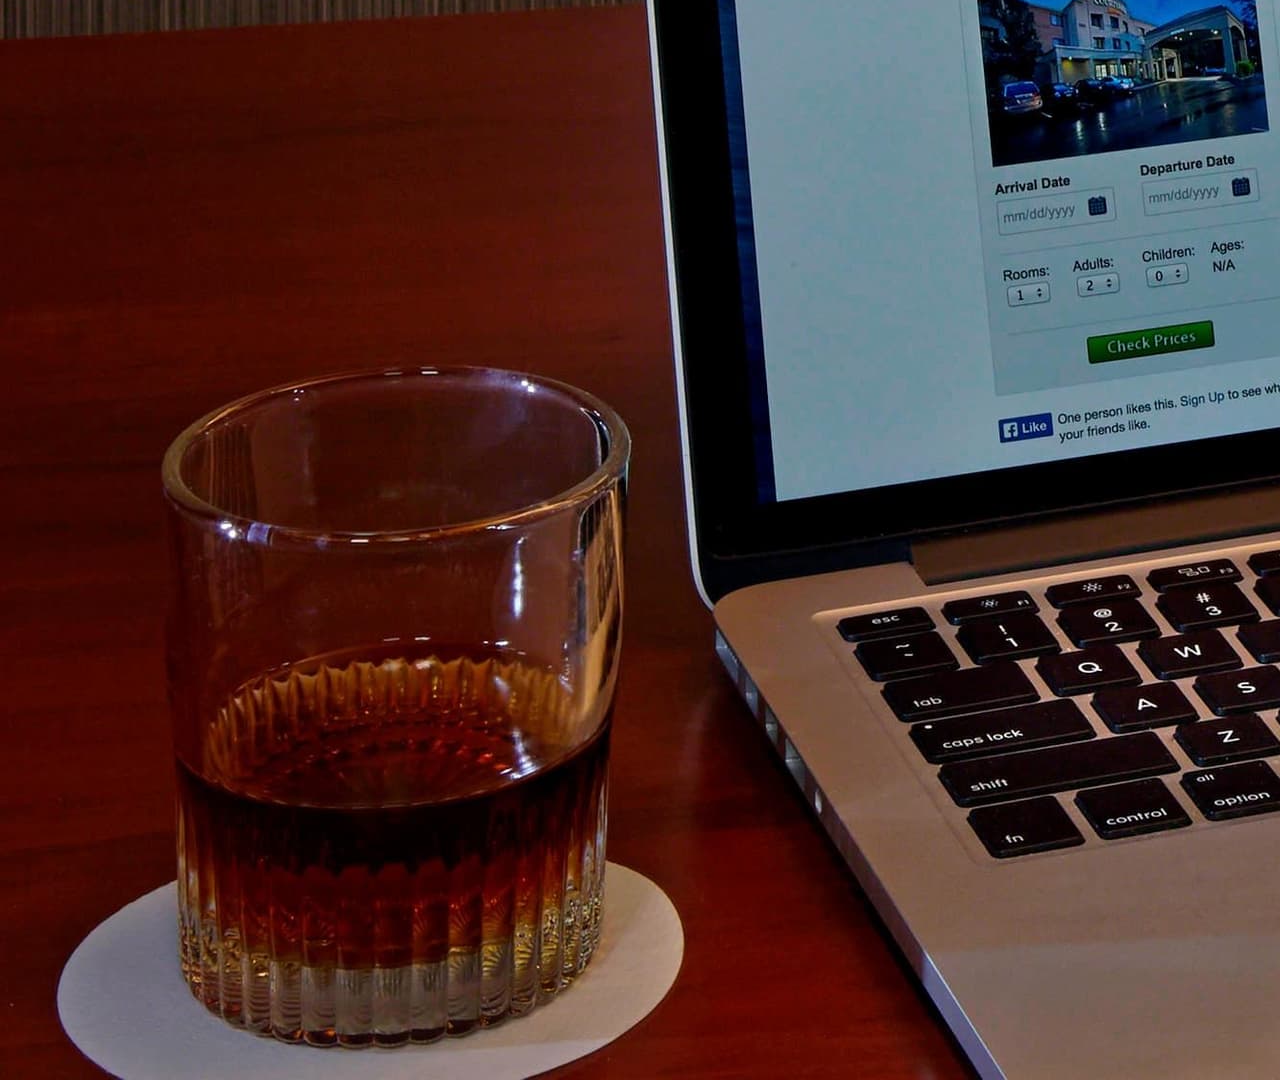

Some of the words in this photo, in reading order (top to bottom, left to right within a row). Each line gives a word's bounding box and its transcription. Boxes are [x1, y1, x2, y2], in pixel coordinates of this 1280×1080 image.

[1139, 159, 1203, 177] Departure
[1205, 154, 1235, 168] Date
[994, 178, 1038, 196] Arrival
[1040, 175, 1071, 189] Date
[1148, 185, 1220, 203] mm/dd/yyyy
[1003, 204, 1076, 224] mm/dd/yyyy
[1141, 247, 1195, 263] Children:
[1210, 240, 1245, 255] Ages:
[1072, 257, 1114, 273] Adults:
[1212, 258, 1236, 272] N/A
[1002, 266, 1050, 282] Rooms:
[1154, 269, 1164, 282] 0
[1086, 279, 1094, 291] 2
[1016, 289, 1024, 301] 1
[1107, 335, 1150, 353] Check
[1153, 332, 1196, 347] Prices
[1056, 412, 1083, 425] One
[1083, 407, 1124, 425] person
[1125, 403, 1152, 415] likes
[1153, 398, 1178, 411] this.
[1179, 394, 1206, 408] Sign
[1207, 391, 1226, 404] Up
[1227, 389, 1240, 400] to
[1241, 386, 1262, 398] see
[1021, 421, 1047, 434] Like
[1058, 428, 1085, 444] your
[1085, 421, 1126, 437] friends
[1127, 418, 1150, 431] like.
[870, 613, 901, 625] esc
[913, 696, 943, 708] tab
[942, 736, 984, 749] caps
[986, 729, 1024, 742] lock
[970, 778, 1009, 792] shift
[1213, 792, 1271, 806] option
[1106, 807, 1168, 825] control
[1005, 834, 1025, 844] fn
